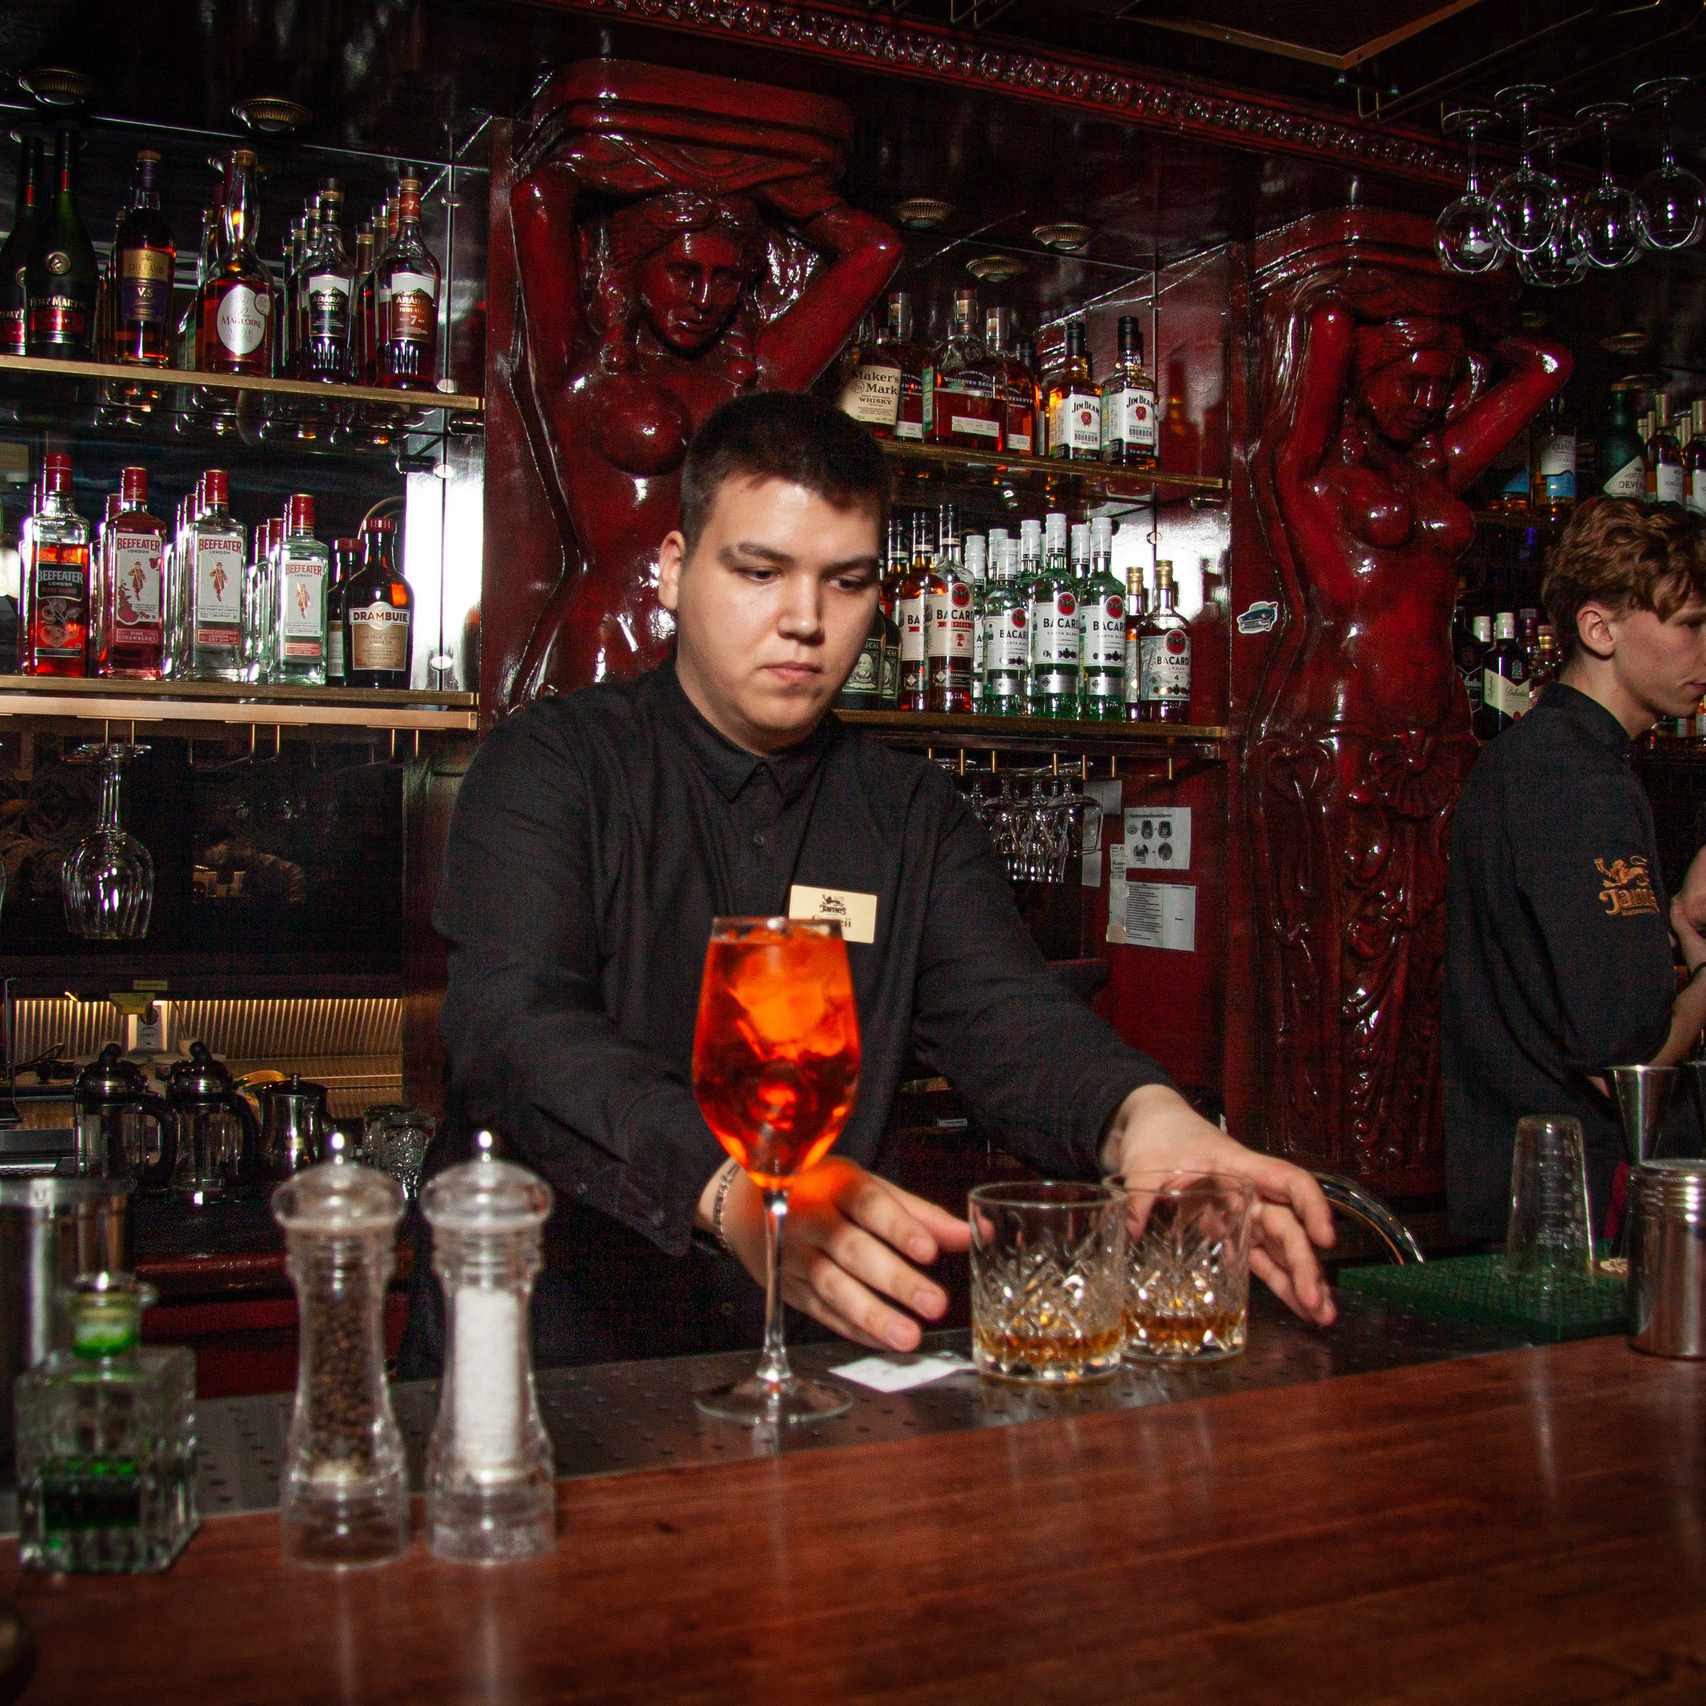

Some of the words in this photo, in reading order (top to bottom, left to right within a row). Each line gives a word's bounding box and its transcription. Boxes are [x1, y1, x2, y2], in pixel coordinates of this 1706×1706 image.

[408, 200, 415, 210] 7
[221, 315, 262, 329] MAGLOIRE
[410, 315, 418, 325] 7
[865, 383, 898, 396] Mark
[859, 397, 892, 405] WHISKY
[1126, 396, 1138, 408] JIM
[1071, 402, 1083, 413] JIM
[1074, 433, 1098, 442] BOURBON
[1129, 428, 1152, 437] BOURBON
[117, 538, 160, 553] BEEFEATER
[199, 537, 242, 554] BEEFEATER
[285, 564, 322, 576] BEEFEATER
[38, 570, 84, 584] BEEFEATER
[353, 611, 408, 623] DRAMBUIE
